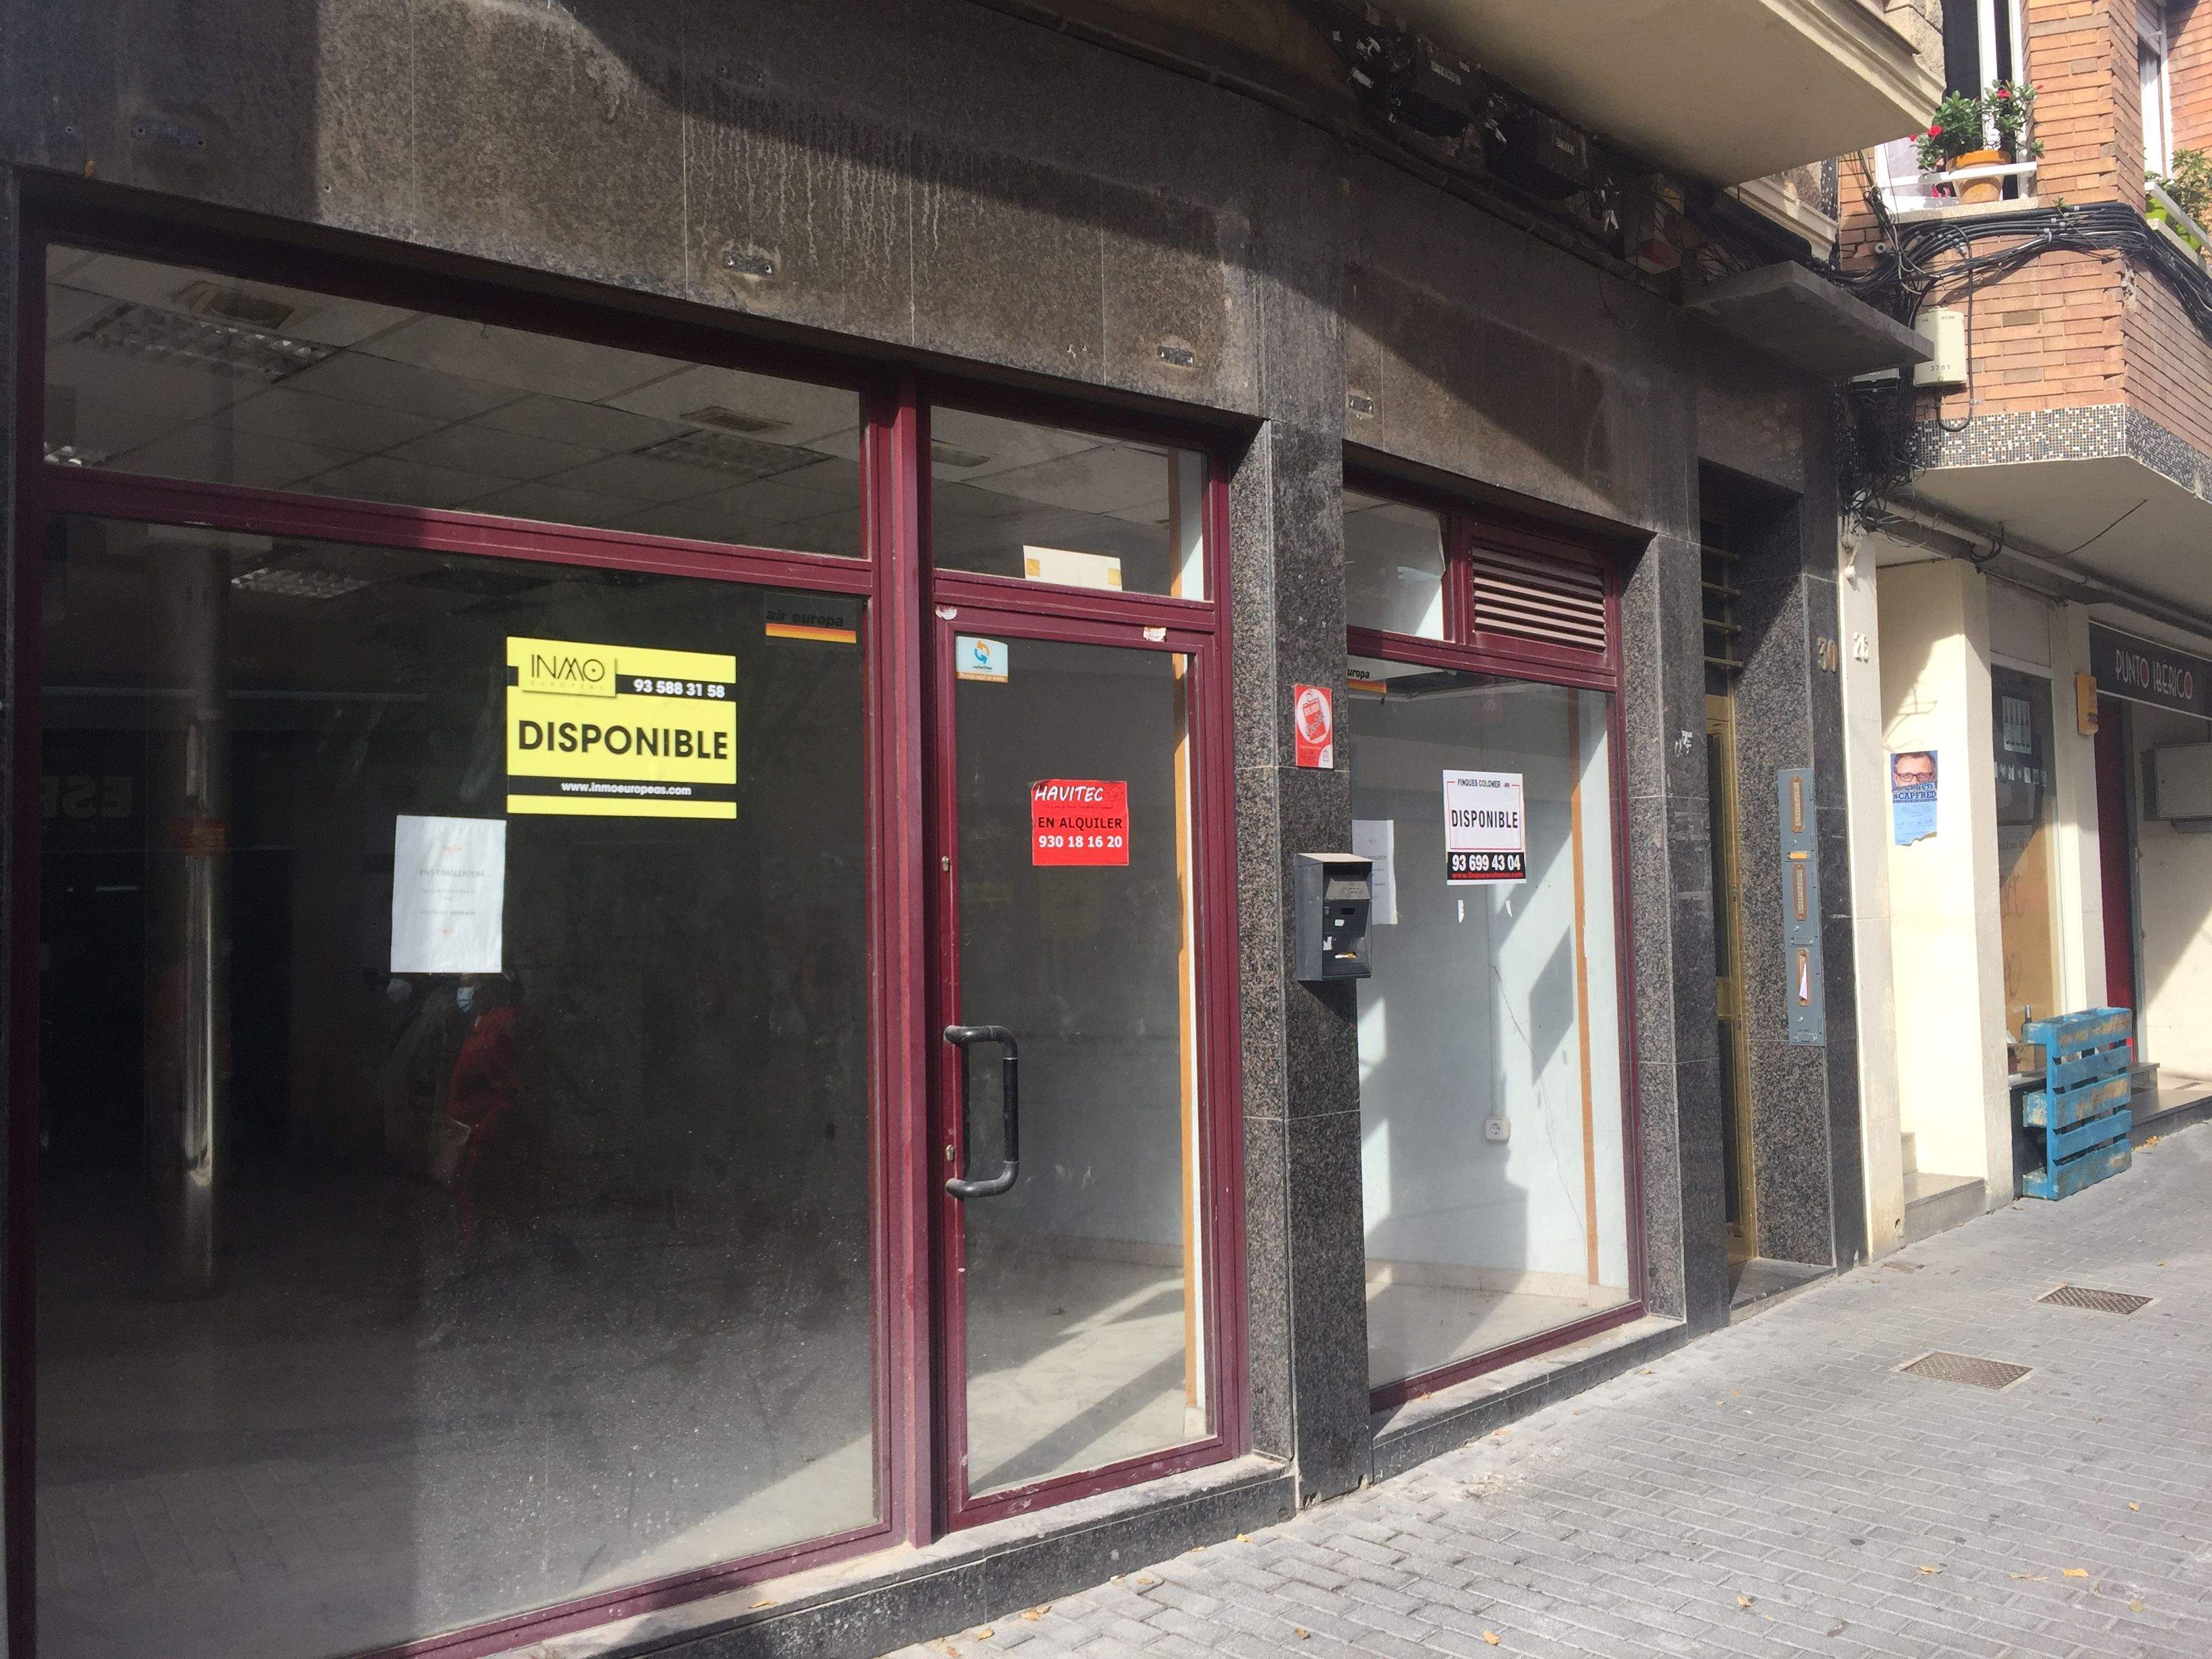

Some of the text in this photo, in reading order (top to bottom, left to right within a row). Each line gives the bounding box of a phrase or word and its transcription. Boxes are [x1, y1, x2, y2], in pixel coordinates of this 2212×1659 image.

[792, 613, 844, 627] europa
[531, 654, 605, 682] INMO
[1347, 669, 1370, 680] uropa
[2115, 649, 2193, 700] PUNTO IBÉRICO
[633, 678, 726, 698] 93 588 31 58
[519, 720, 728, 760] DISPONIBLE
[561, 781, 692, 796] www.inmoeuropeas.com
[1034, 785, 1105, 802] HAVITEC
[1038, 817, 1122, 831] EN ALQUILER
[1452, 810, 1518, 829] DISPONIBLE
[1038, 834, 1123, 848] 930 18 16 20
[1452, 854, 1521, 872] 93 699 43 04
